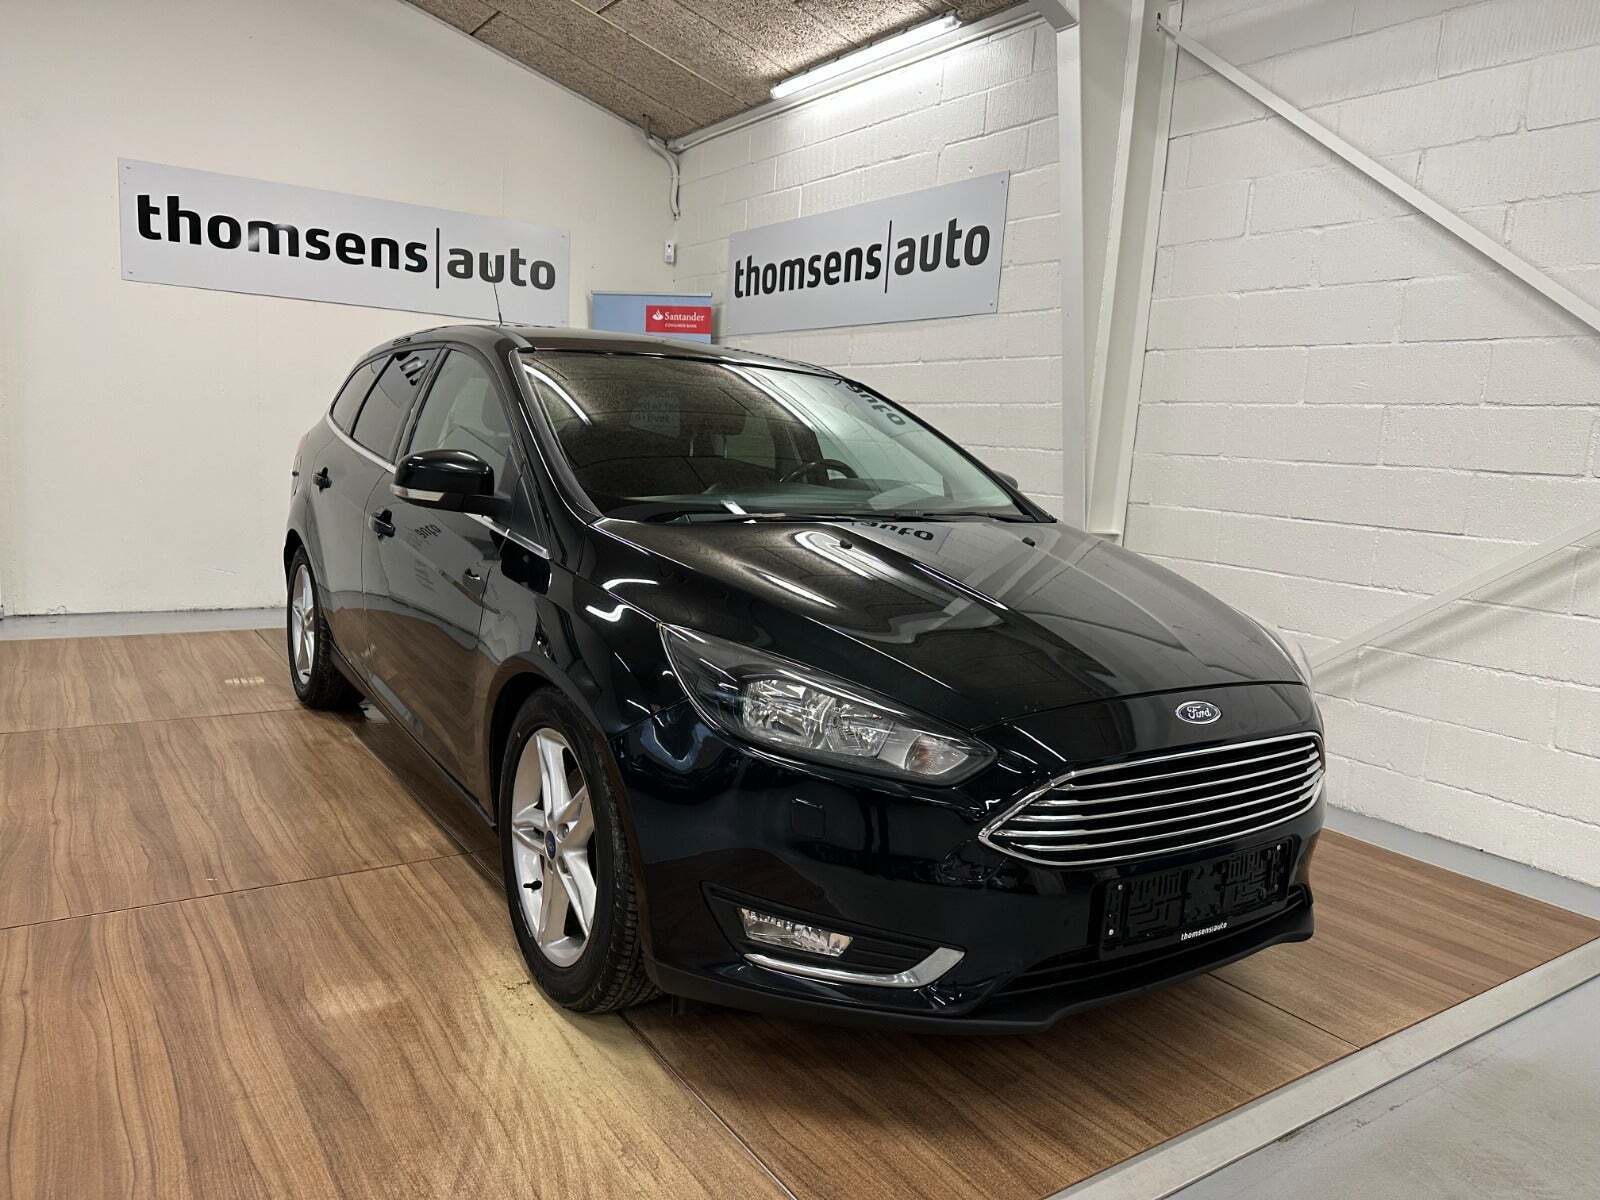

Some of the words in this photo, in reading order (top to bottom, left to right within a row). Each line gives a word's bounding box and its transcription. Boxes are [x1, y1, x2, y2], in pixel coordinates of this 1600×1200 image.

[137, 194, 428, 273] thomsens
[446, 247, 556, 291] auto
[734, 243, 883, 299] thomsens
[894, 217, 991, 276] auto
[664, 311, 705, 322] Santander
[1187, 705, 1211, 719] Ford
